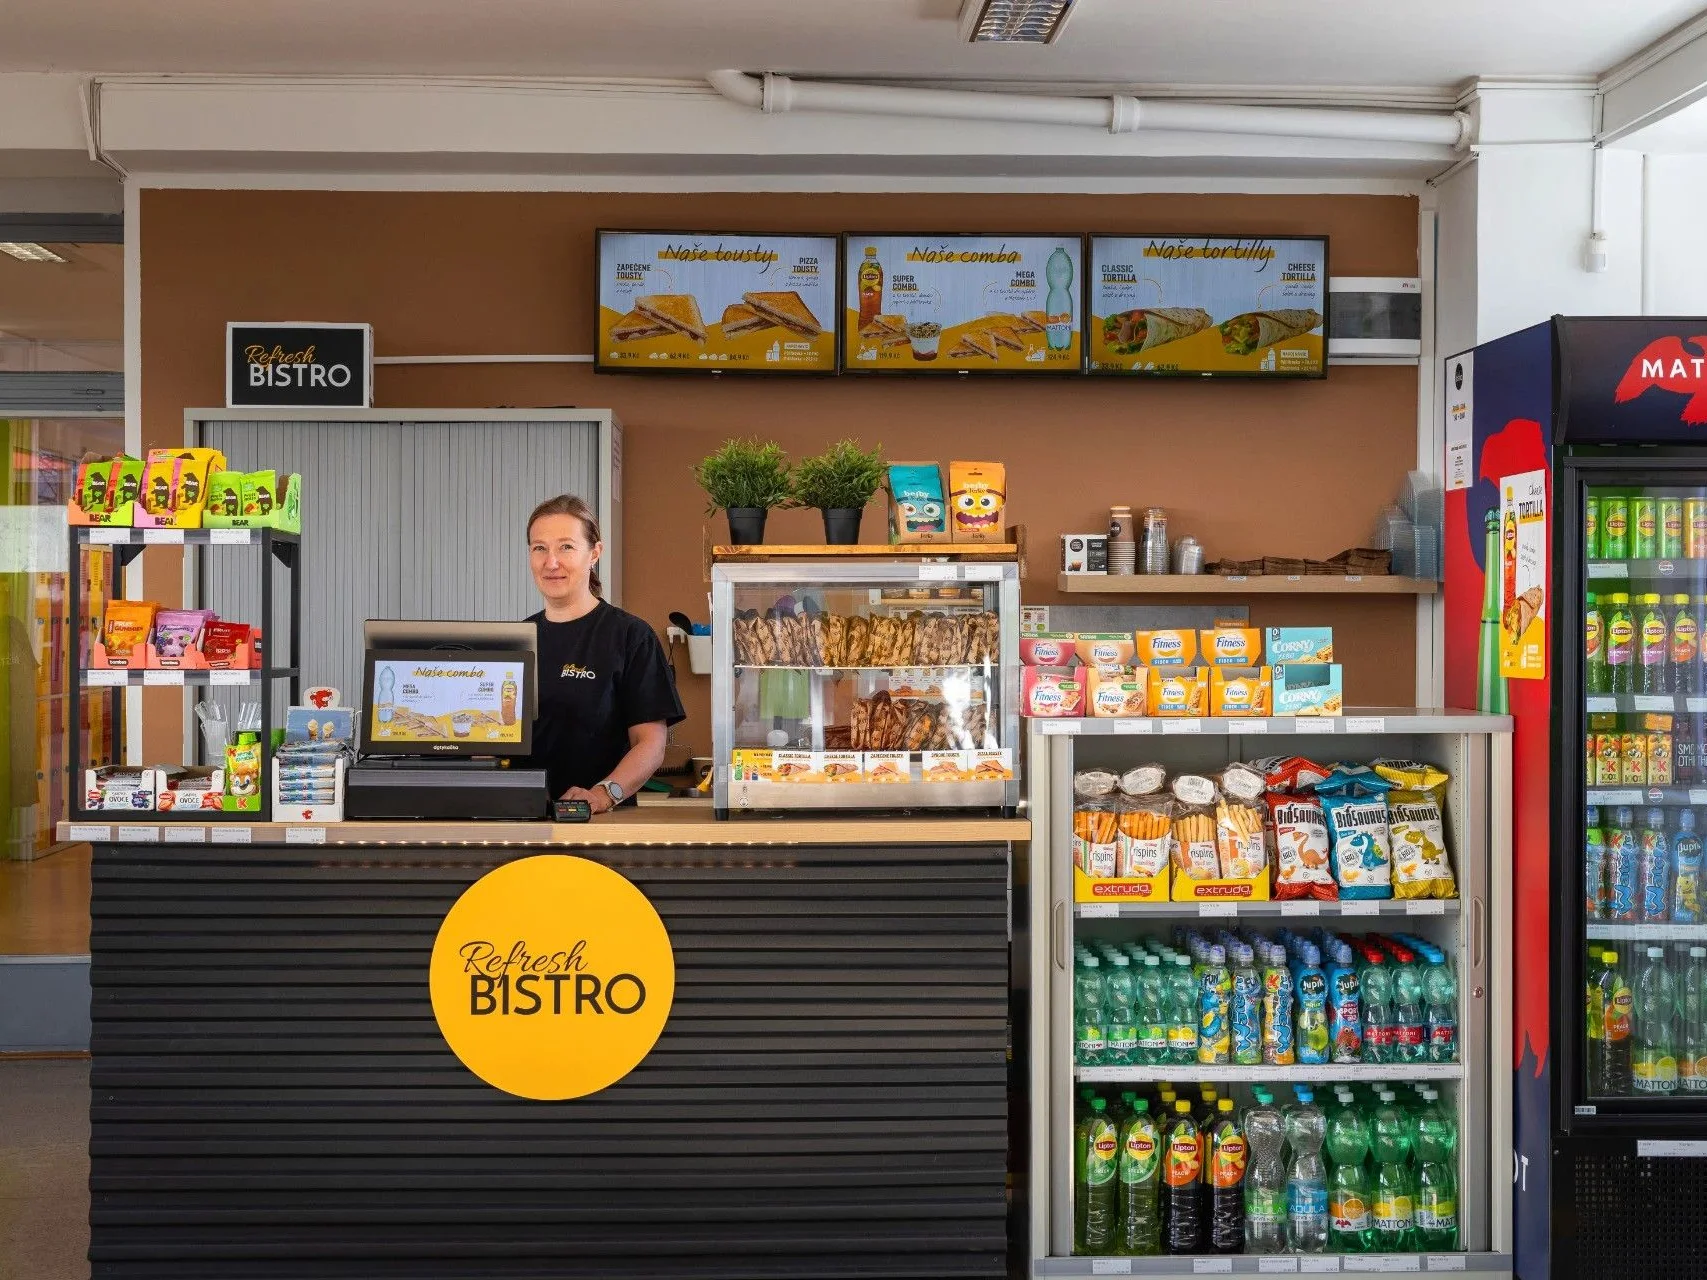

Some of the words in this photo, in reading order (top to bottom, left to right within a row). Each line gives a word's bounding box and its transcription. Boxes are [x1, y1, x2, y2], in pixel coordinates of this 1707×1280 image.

[664, 242, 708, 262] Naše
[714, 243, 774, 274] tousty
[911, 243, 954, 263] Naše
[960, 244, 1018, 264] comba
[1146, 238, 1194, 260] Naše
[1201, 239, 1273, 272] tortilly
[800, 257, 818, 265] PIZZA
[1288, 263, 1315, 271] CHEESE
[245, 345, 316, 371] Refresh
[1641, 358, 1705, 378] MAT
[250, 363, 351, 387] BISTRO
[1519, 500, 1543, 520] TORTILLA
[89, 514, 111, 522] BEAR
[1152, 637, 1181, 648] Fitness
[1216, 636, 1246, 647] Fitness
[1034, 646, 1059, 656] Fitness
[1094, 648, 1118, 657] Fitness
[416, 666, 442, 677] Naše
[446, 666, 484, 678] comba
[561, 669, 596, 679] BISTRO
[1035, 691, 1061, 701] Fitness
[1097, 691, 1125, 703] Fitness
[1162, 687, 1185, 696] Fitness
[1225, 687, 1248, 696] Fitness
[1606, 761, 1616, 772] K
[1631, 761, 1640, 772] K
[1657, 761, 1667, 772] K
[459, 939, 588, 988] Refresh
[470, 973, 646, 1015] BISTRO
[1130, 1142, 1151, 1151] Lipton
[1174, 1144, 1195, 1152] Lipton
[1223, 1144, 1242, 1152] Lipton
[1289, 1204, 1325, 1214] AQUILA
